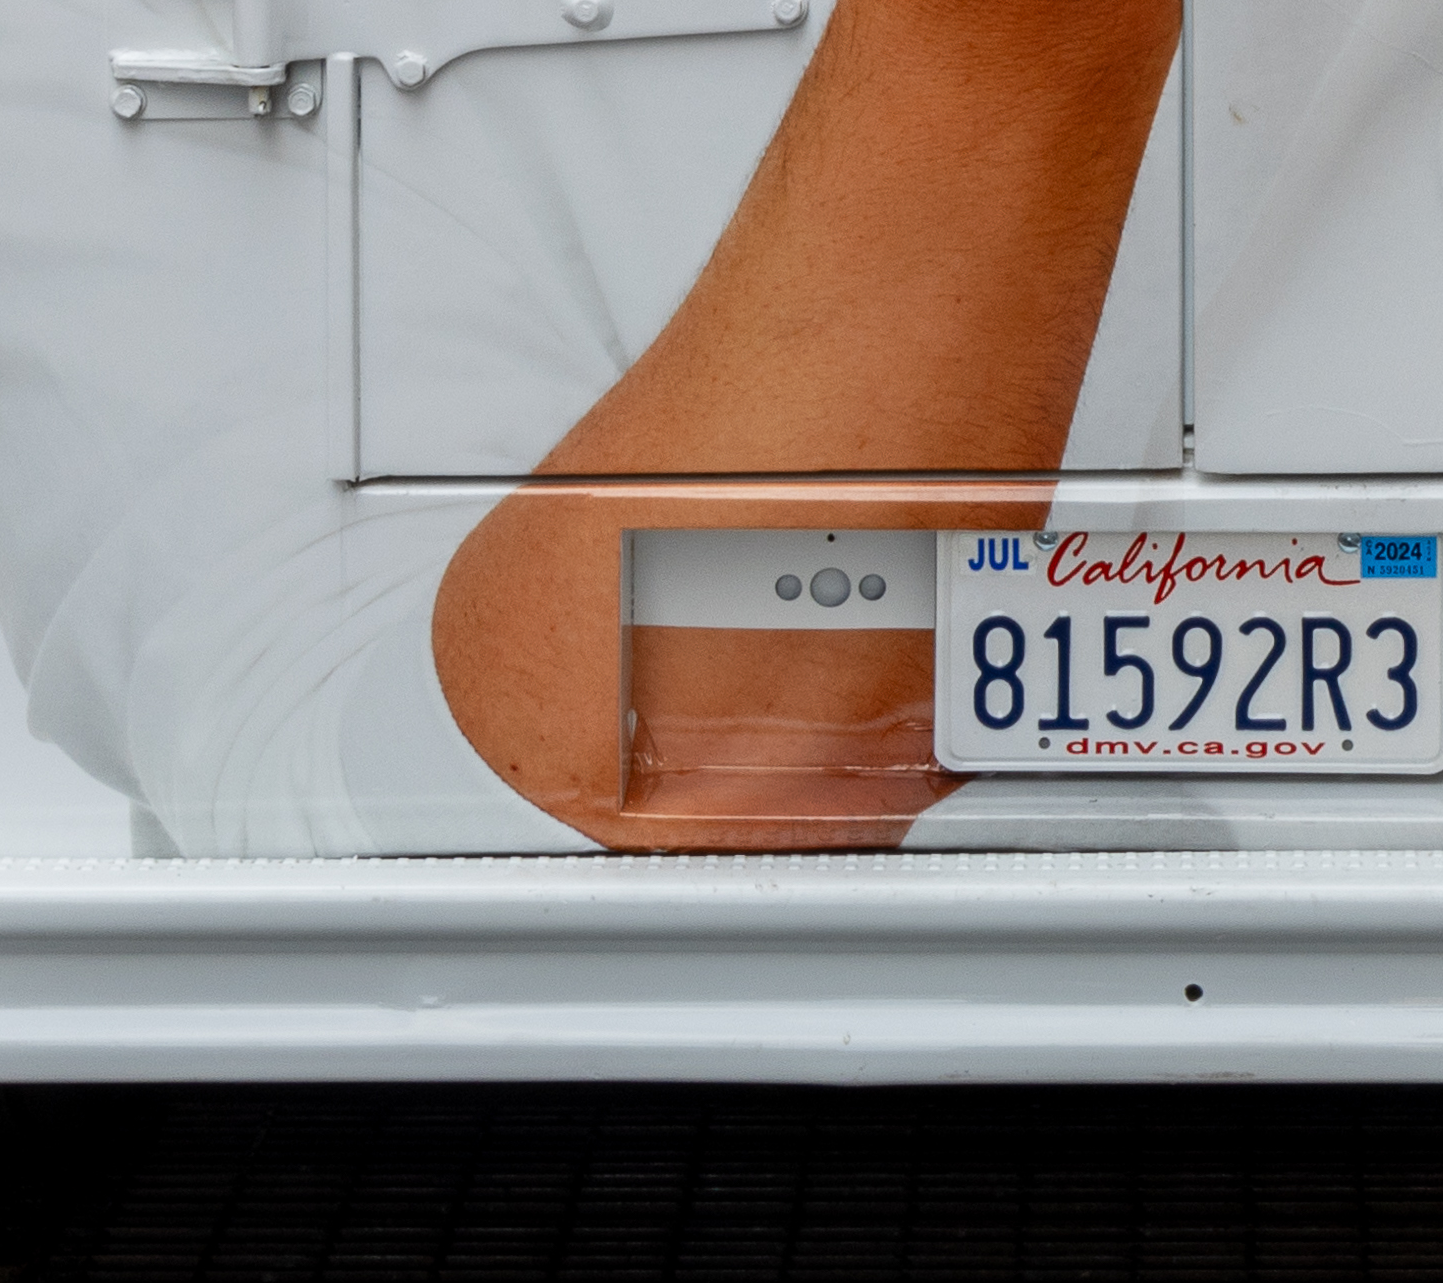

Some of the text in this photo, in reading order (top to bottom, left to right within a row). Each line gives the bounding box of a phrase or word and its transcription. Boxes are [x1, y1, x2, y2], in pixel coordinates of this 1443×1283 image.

[968, 538, 1029, 572] JUL
[1046, 531, 1361, 604] California
[1374, 542, 1423, 561] 2024
[972, 615, 1419, 732] 81592R3
[1066, 737, 1327, 760] dmv.ca.gov
